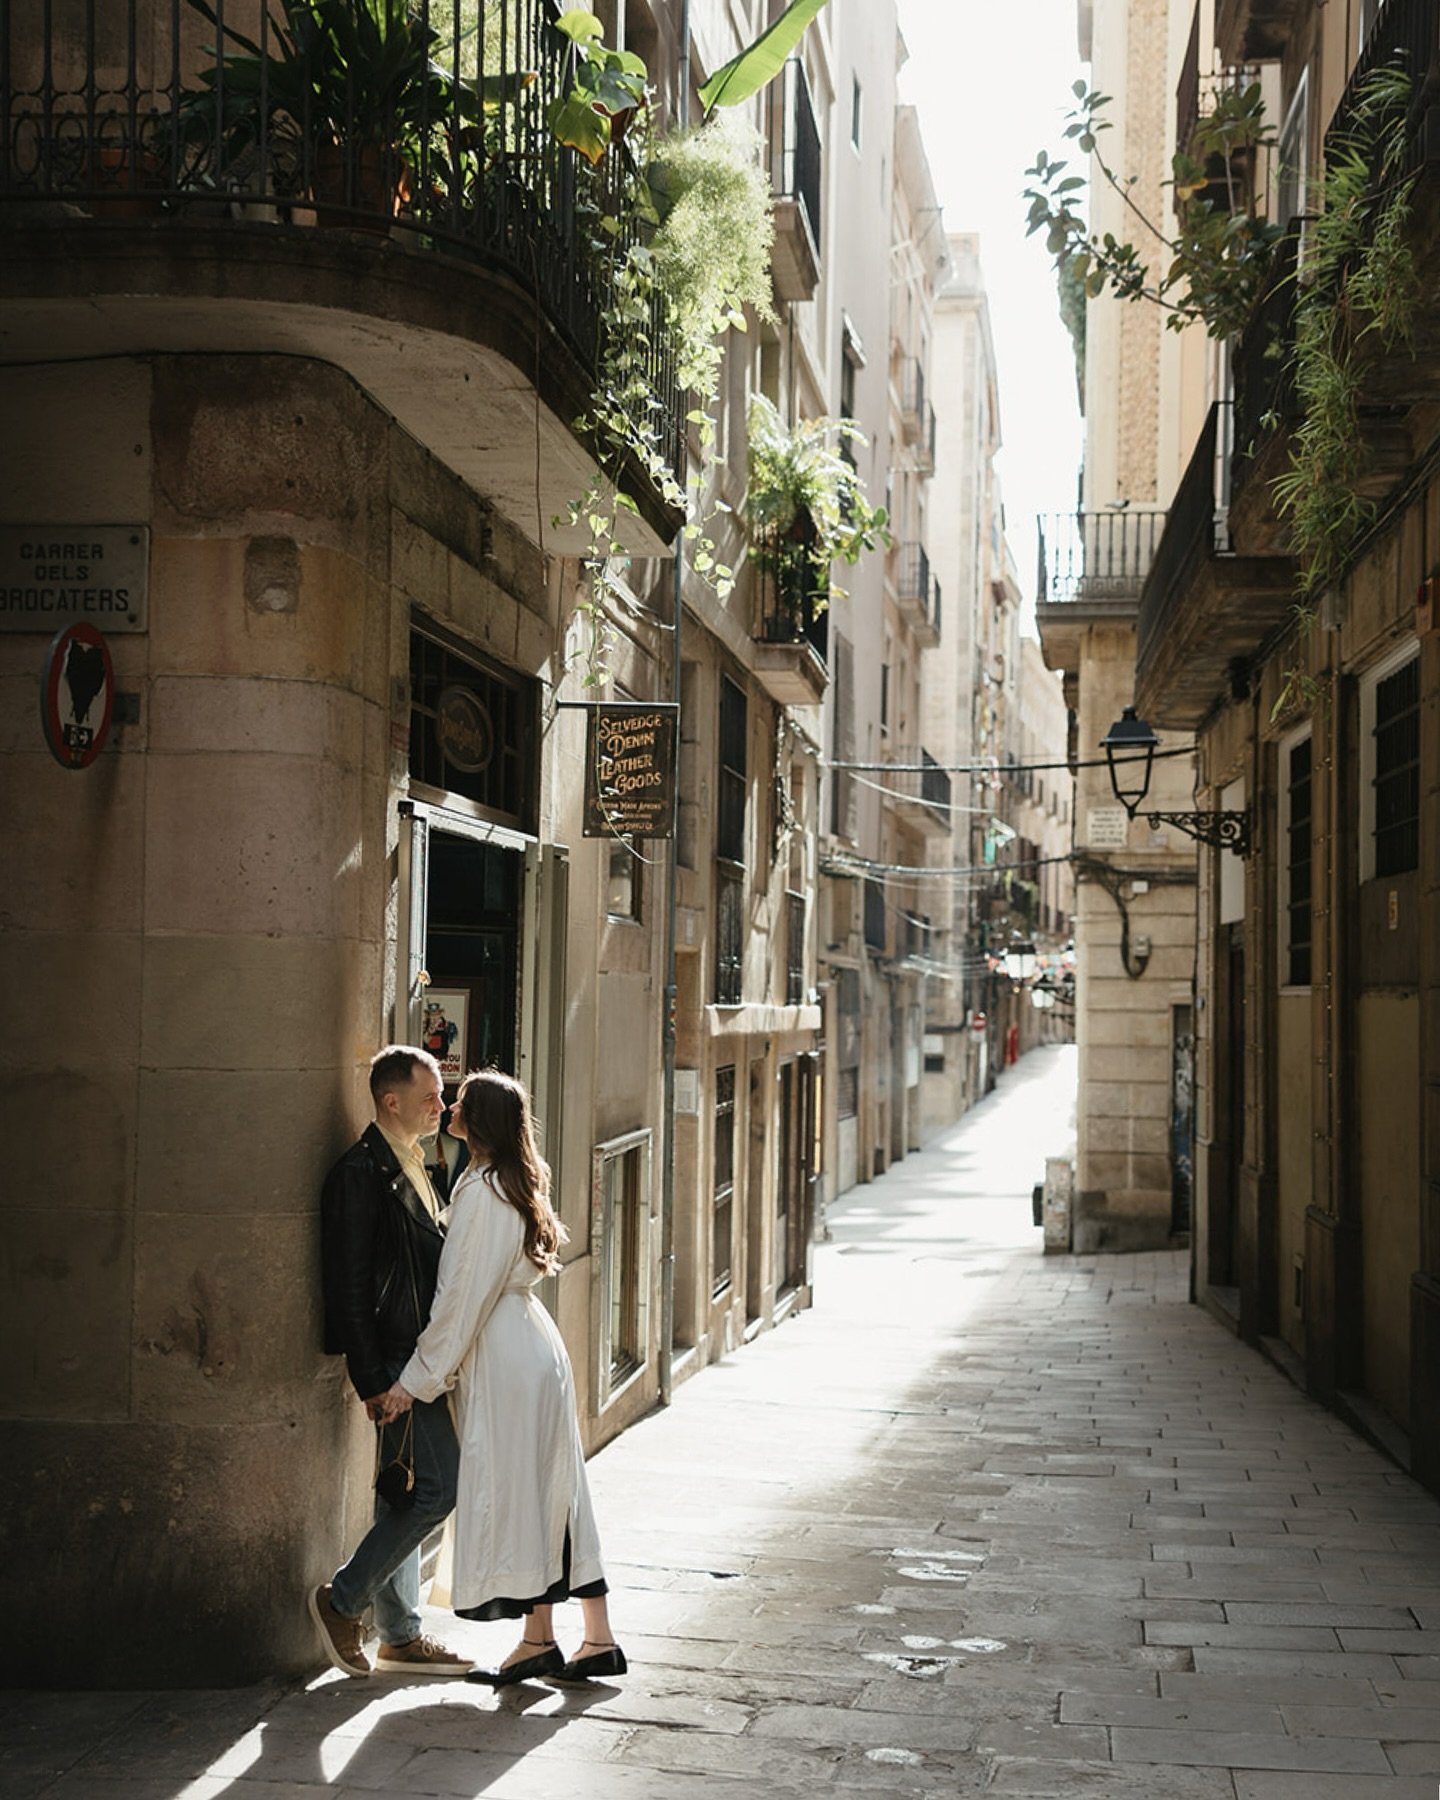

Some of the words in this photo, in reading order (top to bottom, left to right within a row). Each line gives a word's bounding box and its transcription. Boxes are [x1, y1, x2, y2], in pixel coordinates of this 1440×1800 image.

[20, 543, 103, 559] CARRER
[35, 565, 89, 580] DELS
[599, 714, 663, 740] SELVEDGE
[607, 732, 656, 757] DENIM
[600, 754, 653, 780] LEATHER
[614, 771, 662, 795] GOODS
